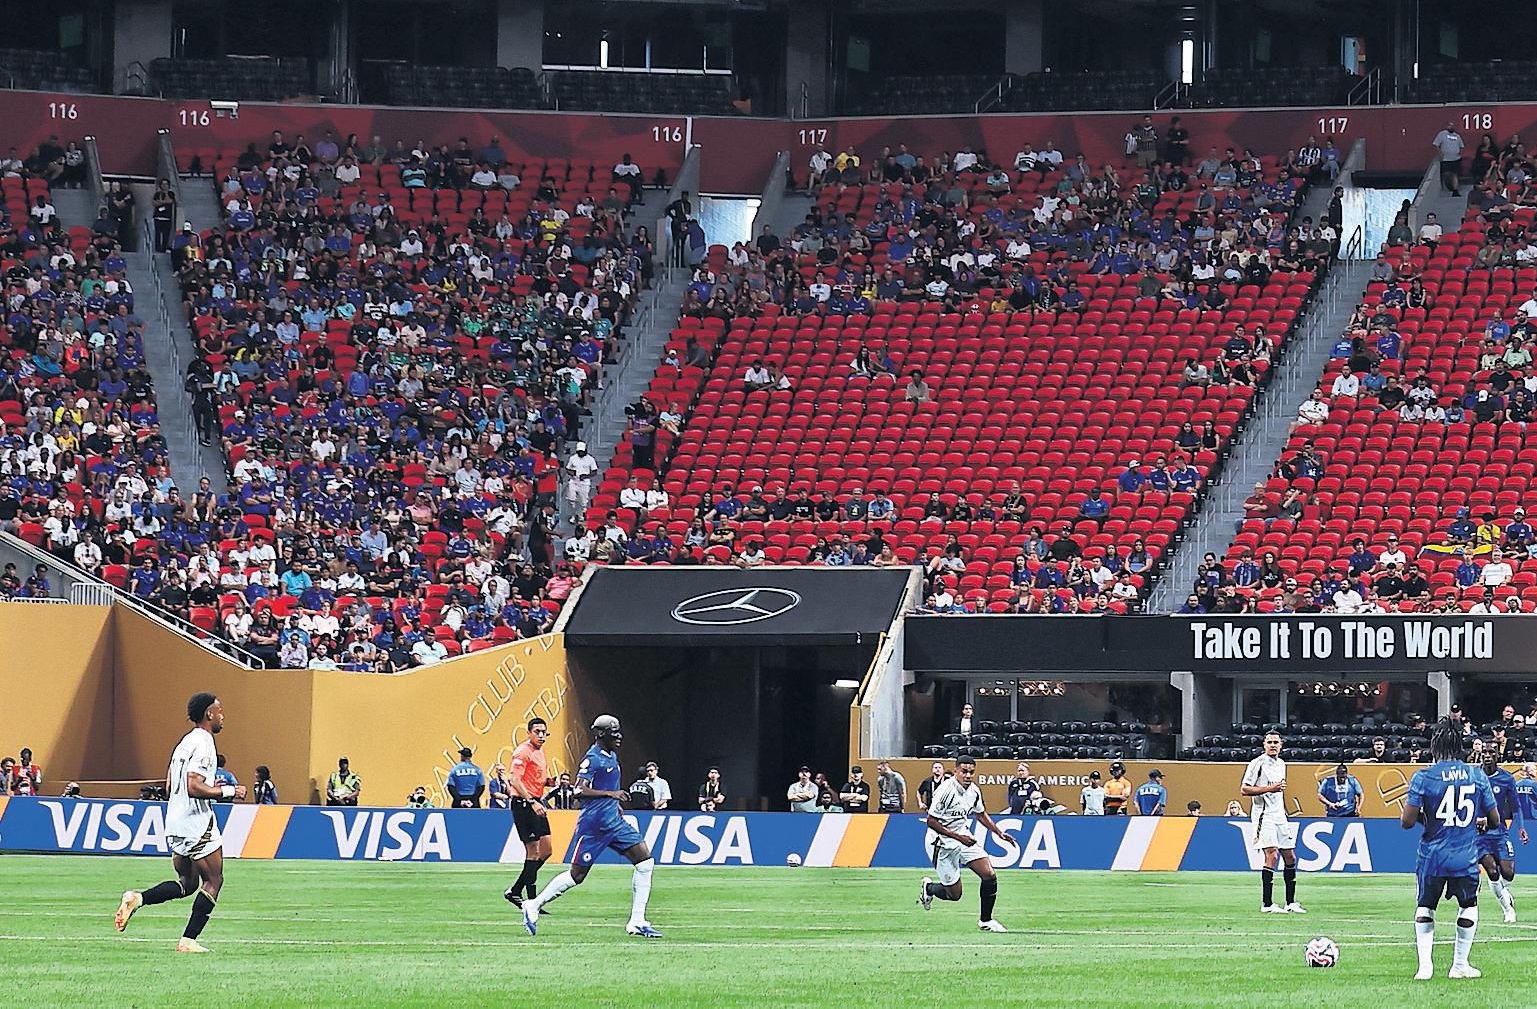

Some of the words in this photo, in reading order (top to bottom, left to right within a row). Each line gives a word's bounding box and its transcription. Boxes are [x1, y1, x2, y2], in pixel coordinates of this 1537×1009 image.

[49, 103, 78, 120] 116
[179, 109, 210, 126] 116
[1318, 117, 1348, 134] 117
[1463, 113, 1493, 130] 118
[652, 126, 682, 142] 116
[799, 129, 828, 146] 117
[1190, 622, 1261, 659] Take
[1269, 622, 1291, 659] It
[1298, 622, 1333, 659] To
[1340, 621, 1395, 659] The
[1402, 621, 1494, 660] World
[466, 653, 526, 735] CLUB
[1038, 775, 1092, 787] AMERIC
[1441, 770, 1469, 782] LAVIA
[1435, 783, 1476, 828] 45
[38, 801, 170, 854] VISA
[319, 810, 452, 861] VISA
